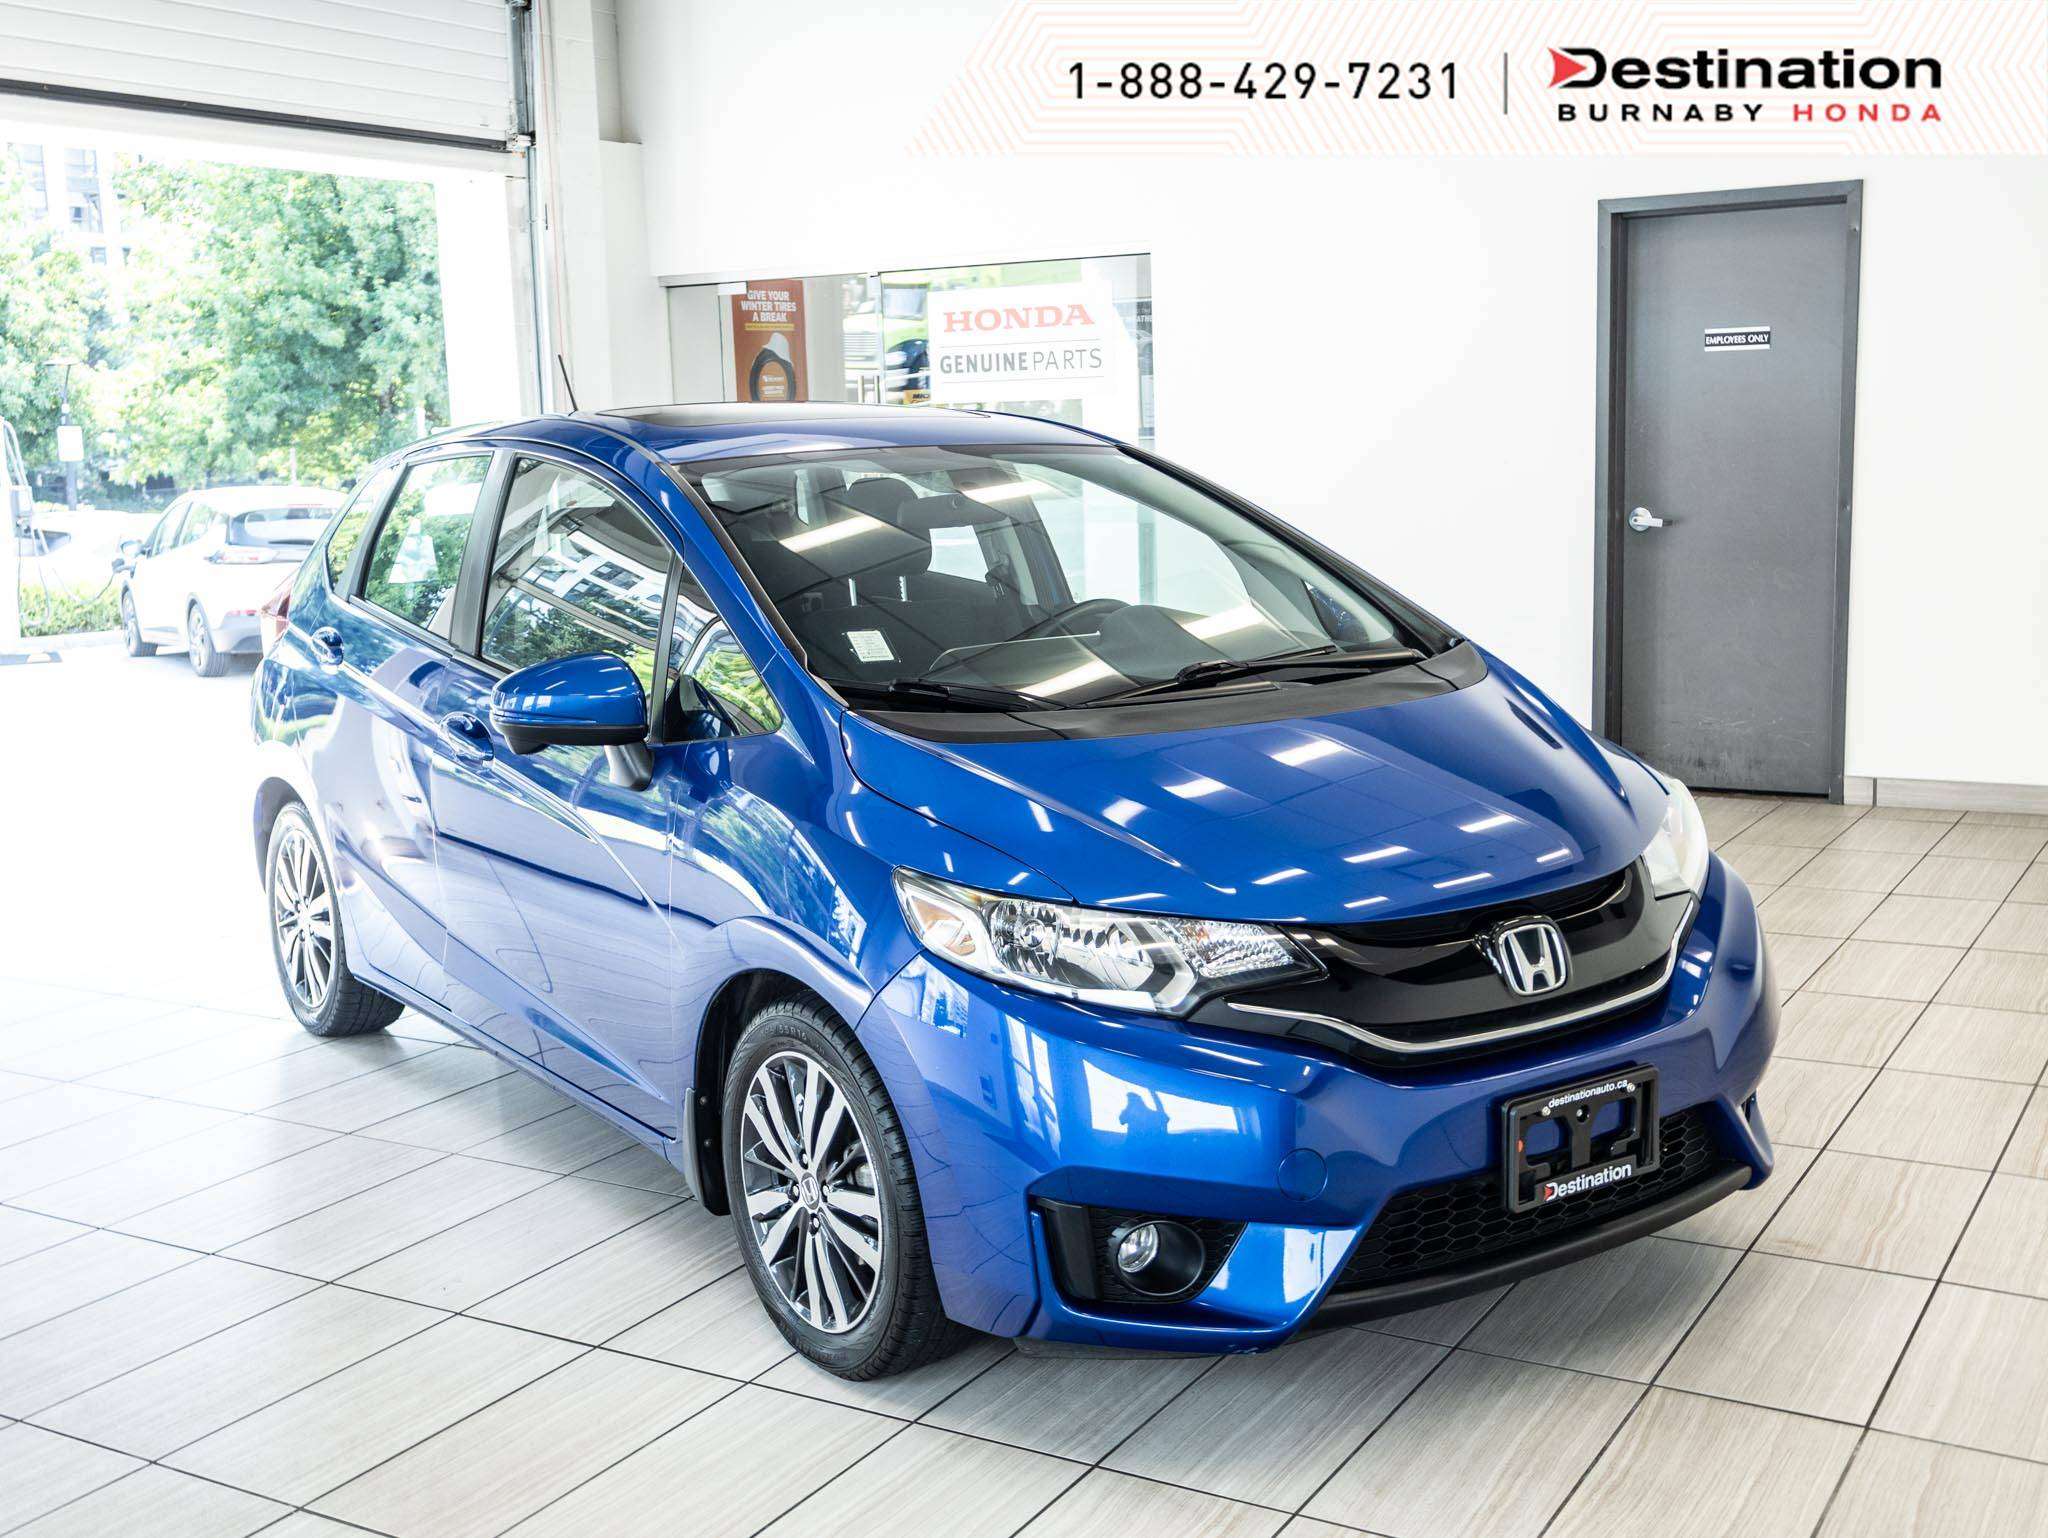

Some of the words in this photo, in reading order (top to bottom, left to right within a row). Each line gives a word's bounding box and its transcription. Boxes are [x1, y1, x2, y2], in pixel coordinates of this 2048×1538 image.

[747, 290, 767, 300] GIVE
[768, 291, 790, 301] YOUR
[740, 301, 773, 311] WINTER
[773, 302, 797, 312] TIRES
[752, 312, 760, 322] A
[760, 312, 788, 322] BREAK
[943, 304, 1095, 333] HONDA
[1705, 335, 1746, 345] EMPLOYEES
[1747, 333, 1769, 343] ONLY
[940, 352, 1028, 374] GENUINE
[1033, 348, 1102, 371] PARTS
[1548, 1079, 1628, 1109] destinationauto.ca
[1545, 1164, 1632, 1201] Destination
